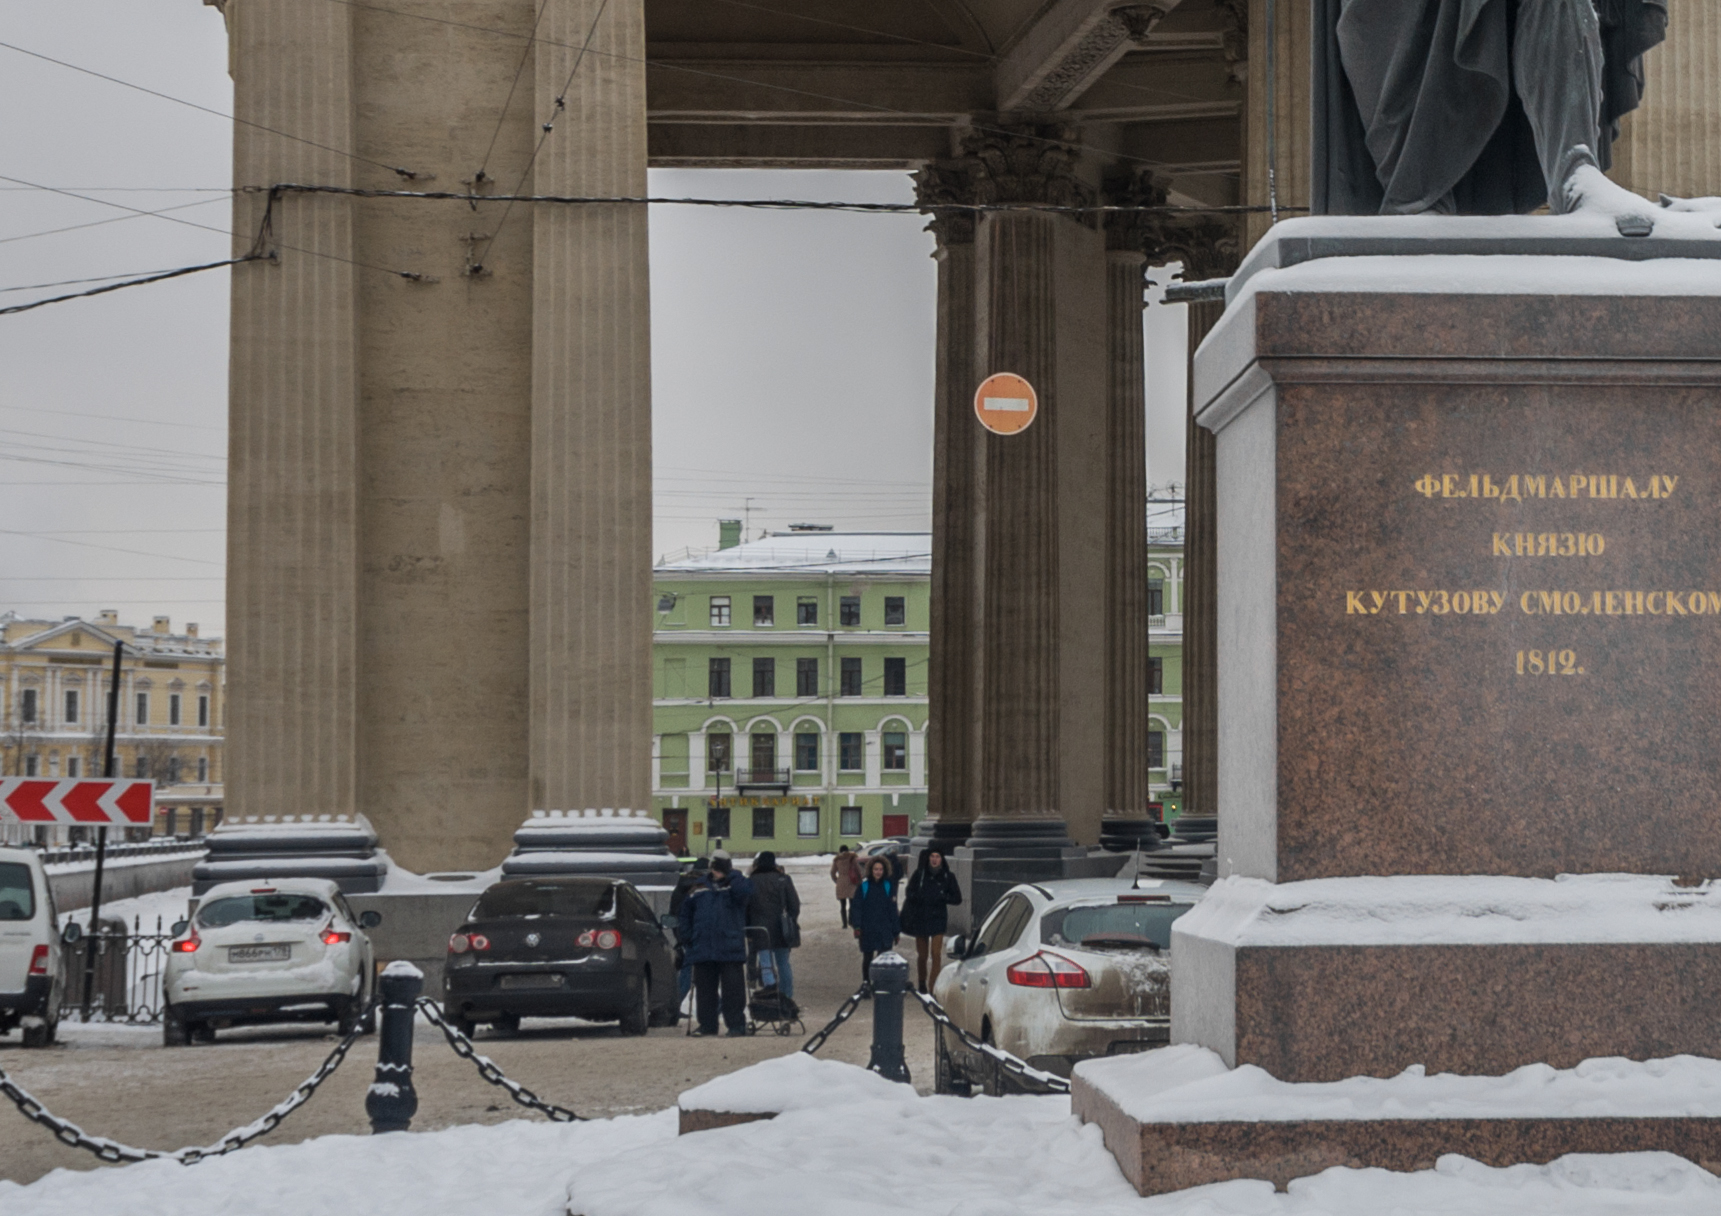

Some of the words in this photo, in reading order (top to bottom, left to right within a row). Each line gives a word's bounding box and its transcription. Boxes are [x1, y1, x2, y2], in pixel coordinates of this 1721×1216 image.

[1414, 473, 1680, 504] ФЕЛЬДМАРШАЛУ
[1492, 532, 1606, 557] КНЯЗЮ
[1345, 589, 1508, 616] КУТУЗОВУ
[1516, 649, 1585, 676] 1812.
